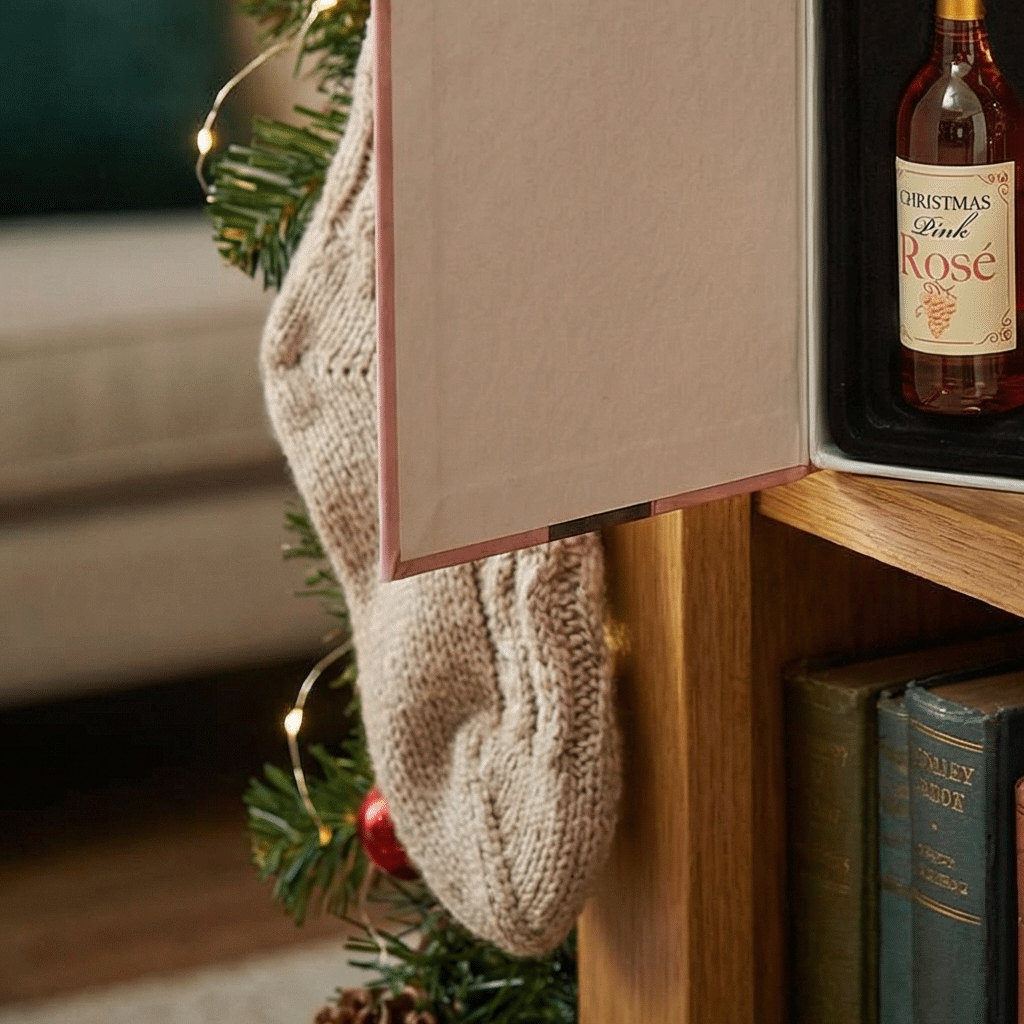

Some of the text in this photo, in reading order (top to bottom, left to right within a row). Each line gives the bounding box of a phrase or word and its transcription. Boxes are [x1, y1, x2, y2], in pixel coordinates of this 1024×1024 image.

[900, 189, 991, 211] CHRISTMAS
[911, 212, 979, 239] Pink
[900, 232, 996, 282] Rosé
